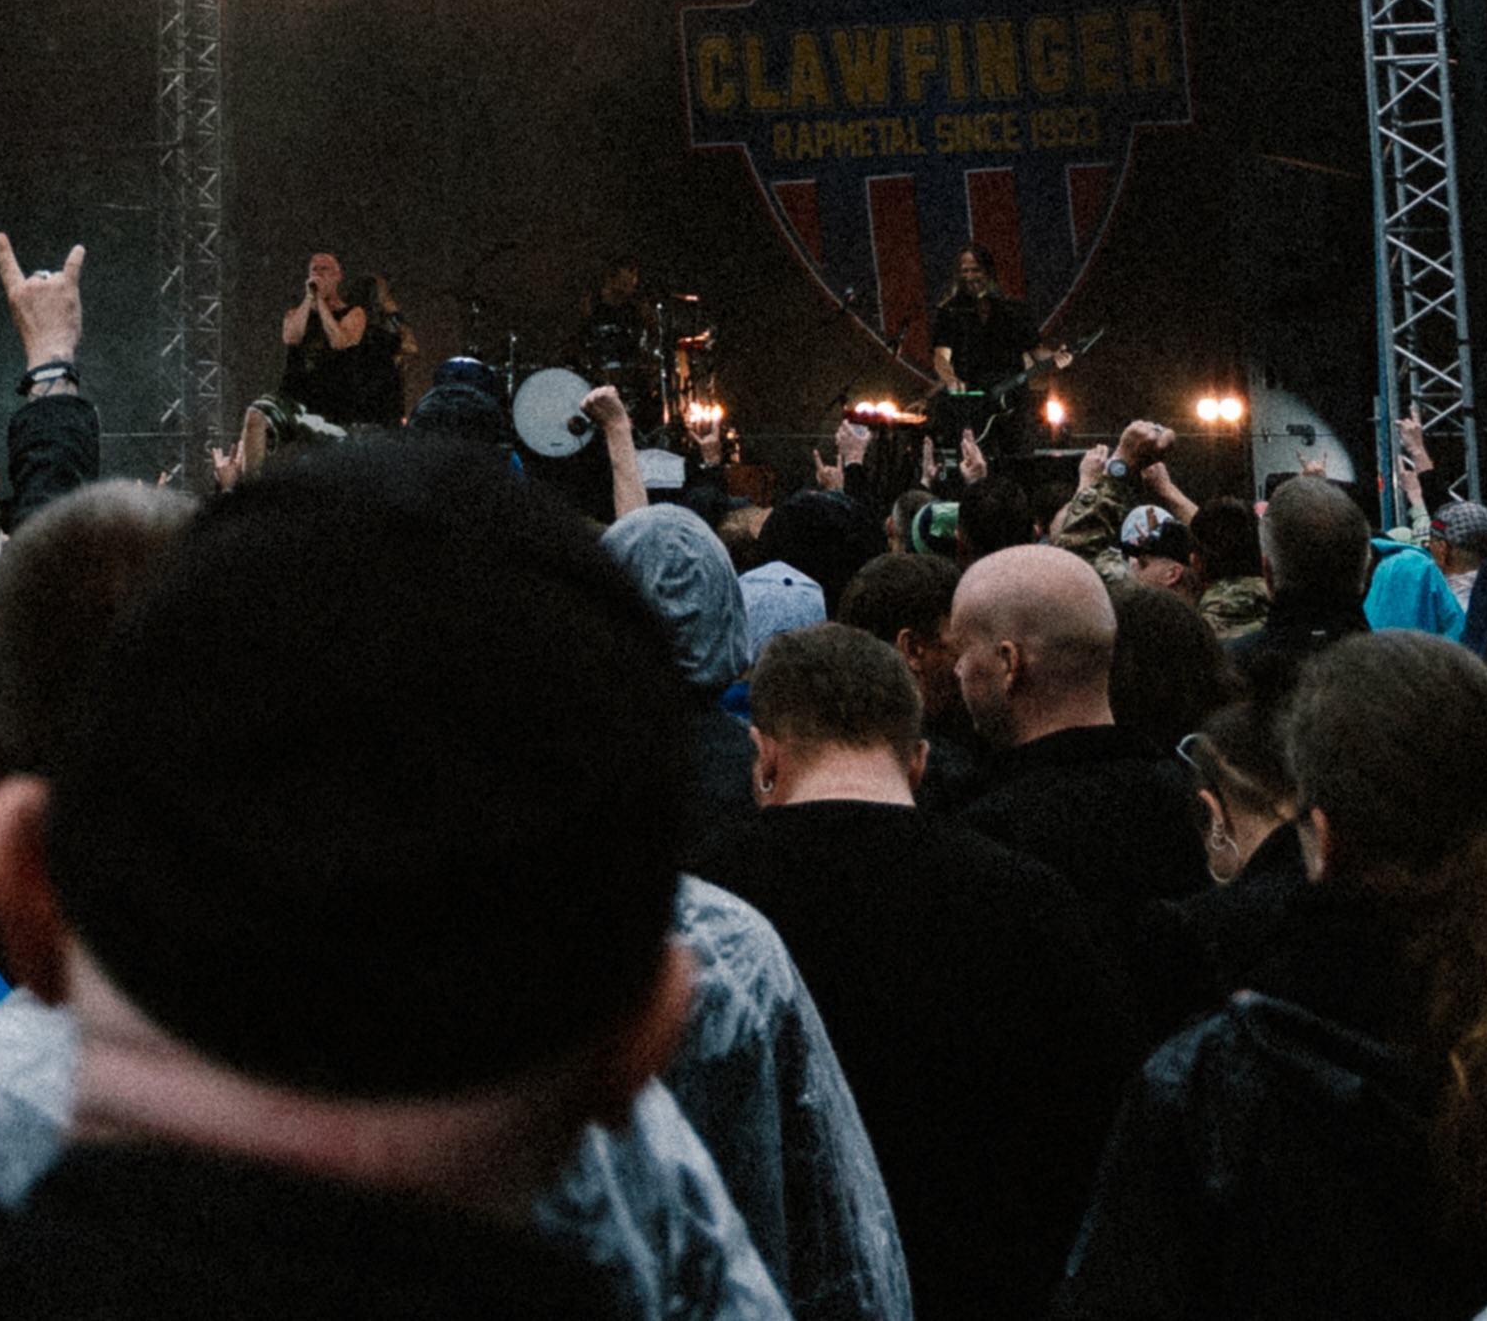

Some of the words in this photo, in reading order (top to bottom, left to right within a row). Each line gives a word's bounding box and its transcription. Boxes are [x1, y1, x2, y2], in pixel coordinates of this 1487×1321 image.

[694, 8, 1173, 110] CLAWFINGER
[772, 117, 927, 161] RAPMETAL
[935, 111, 1023, 154] SINCE
[1028, 106, 1100, 150] 1993
